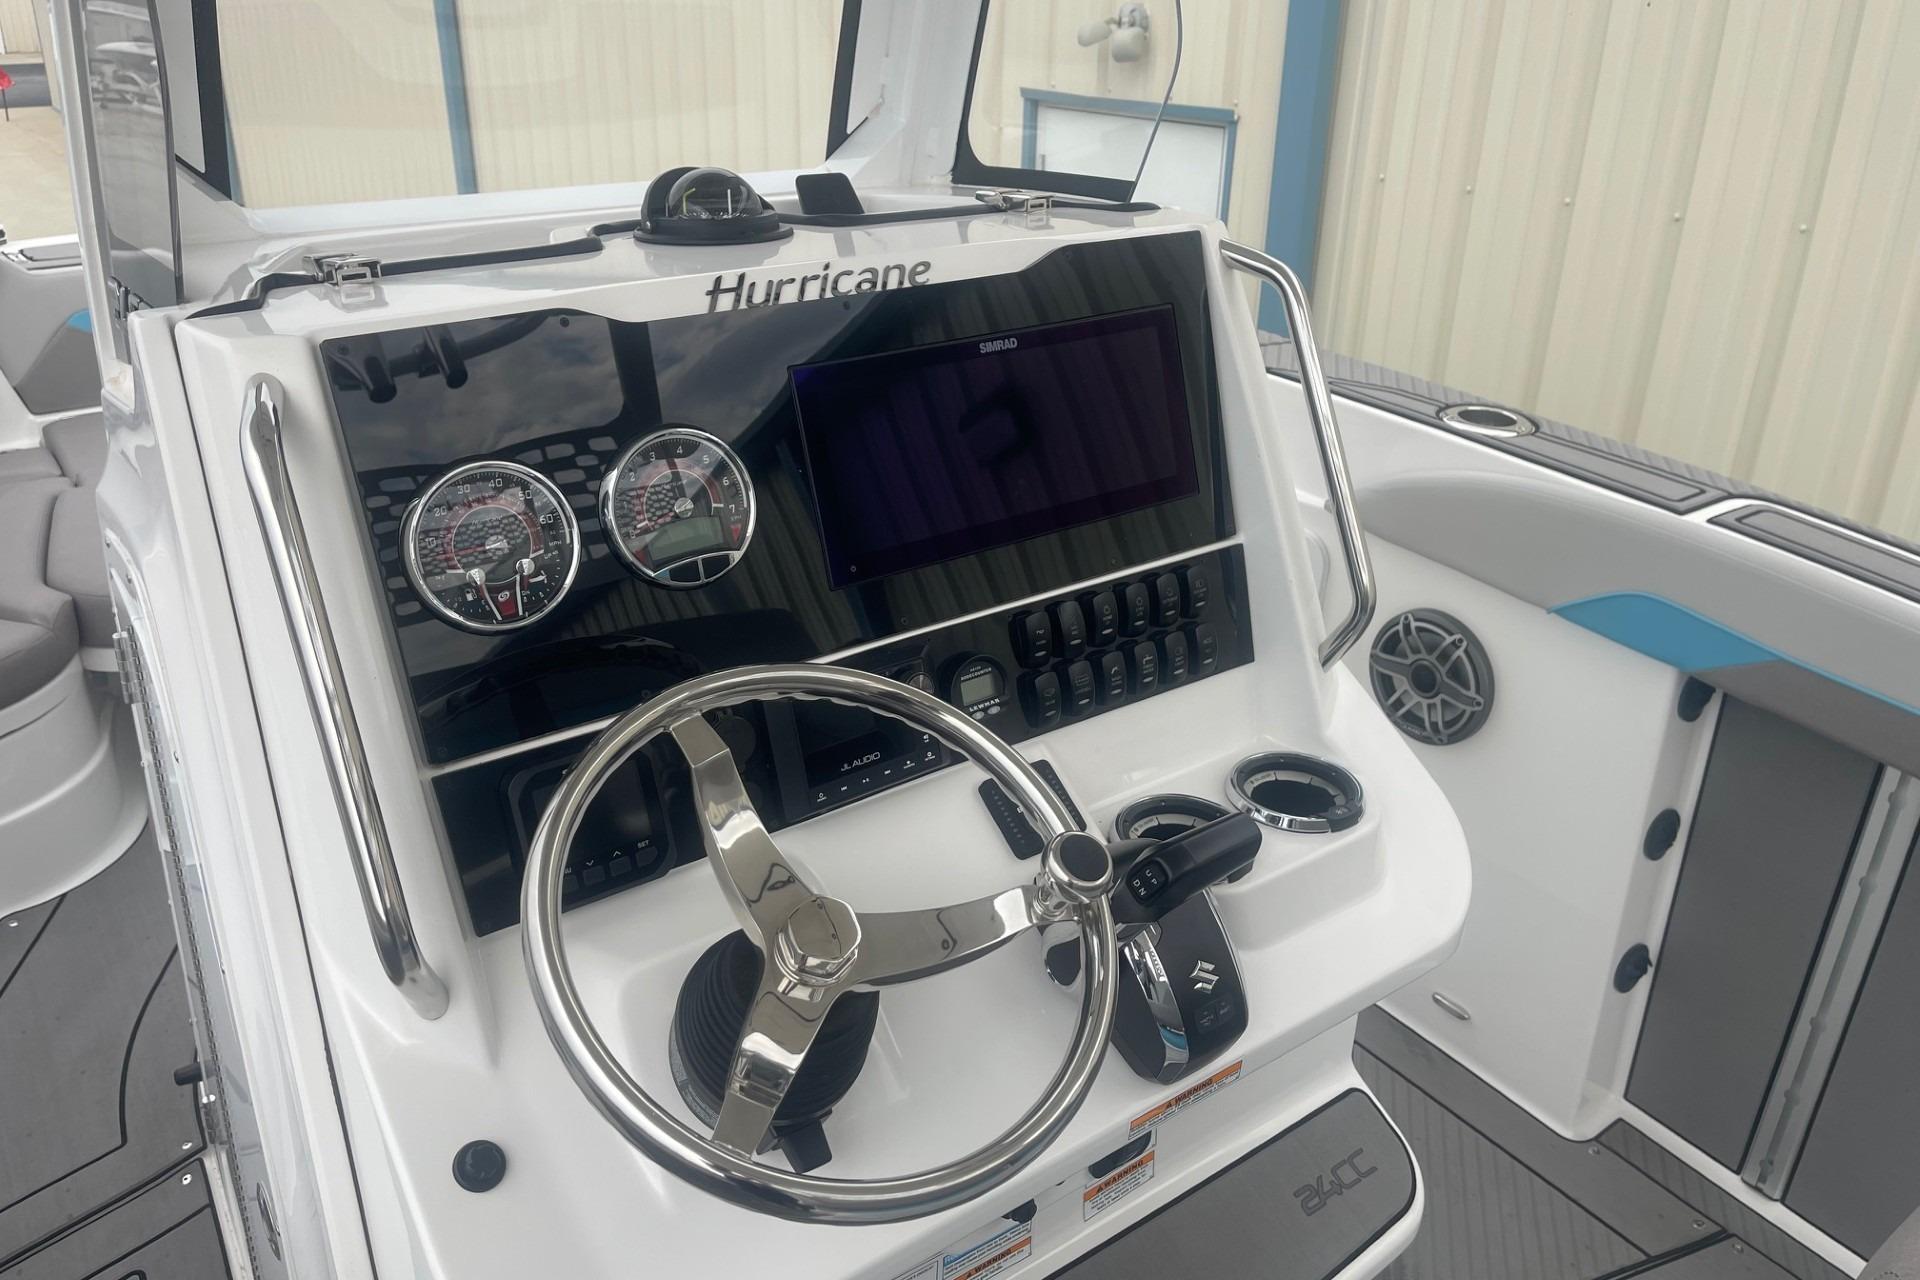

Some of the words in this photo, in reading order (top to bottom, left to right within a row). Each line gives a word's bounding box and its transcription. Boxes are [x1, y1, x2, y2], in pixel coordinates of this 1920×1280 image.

[705, 260, 932, 313] Hurricane
[979, 337, 1018, 353] SIMRAD
[649, 452, 656, 461] 3
[703, 455, 710, 464] 5
[488, 478, 503, 488] 40
[723, 478, 730, 486] 6
[457, 485, 471, 494] 30
[518, 489, 532, 500] 50
[434, 506, 447, 517] 20
[728, 504, 735, 513] 7
[540, 514, 554, 524] 60
[425, 537, 436, 548] 10
[852, 751, 881, 768] AUDIO
[637, 839, 650, 849] SET
[1174, 1078, 1214, 1105] WARNING
[1105, 1159, 1144, 1187] WARNING
[1292, 1147, 1378, 1216] 24CC
[974, 1249, 1012, 1273] WARNING
